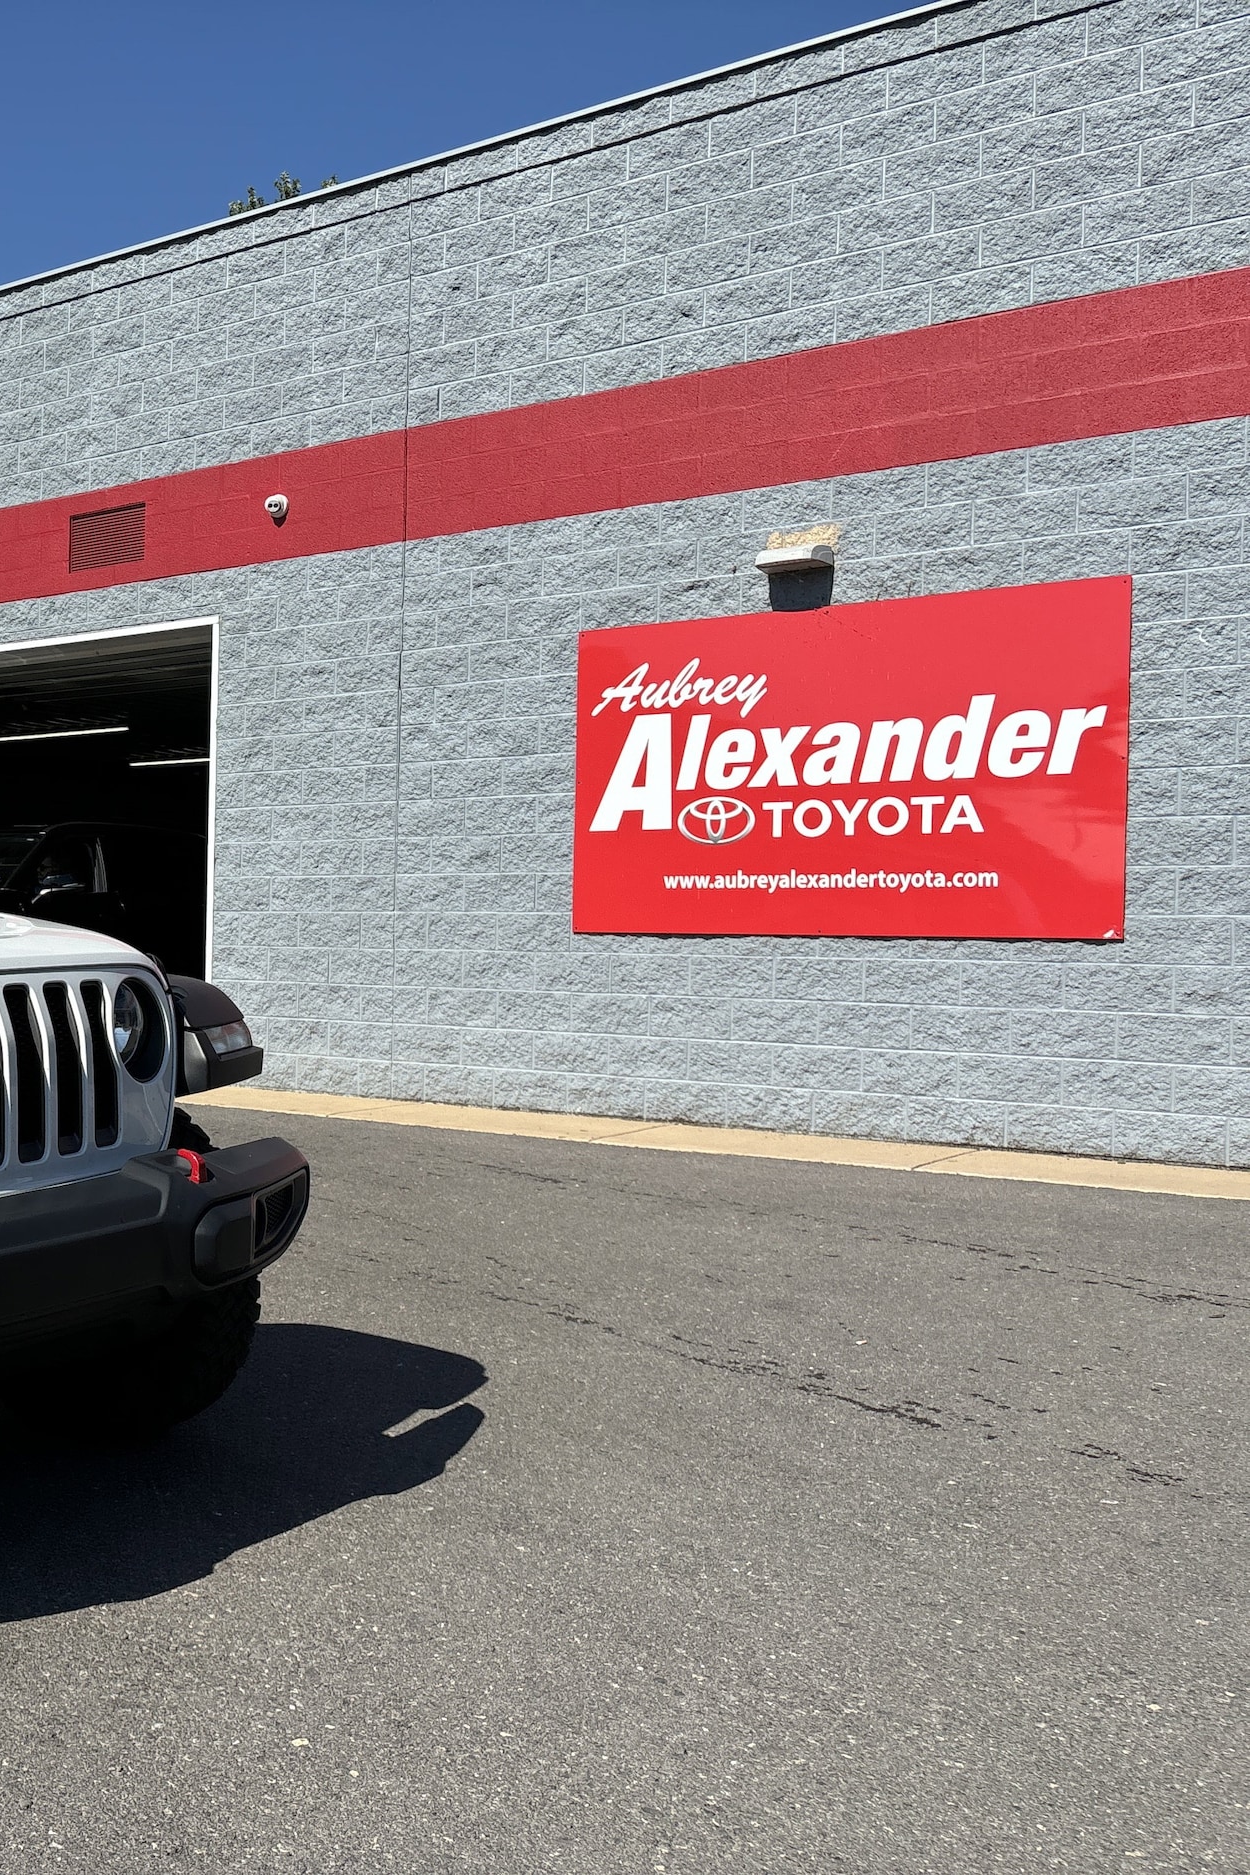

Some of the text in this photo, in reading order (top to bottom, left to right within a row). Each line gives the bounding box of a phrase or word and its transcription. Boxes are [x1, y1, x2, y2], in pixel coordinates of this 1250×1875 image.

[591, 657, 768, 717] Aubrey
[589, 694, 1108, 832] Alexander
[763, 795, 985, 838] TOYOTA
[663, 869, 999, 893] www.aubreyalexandertoyota.com
